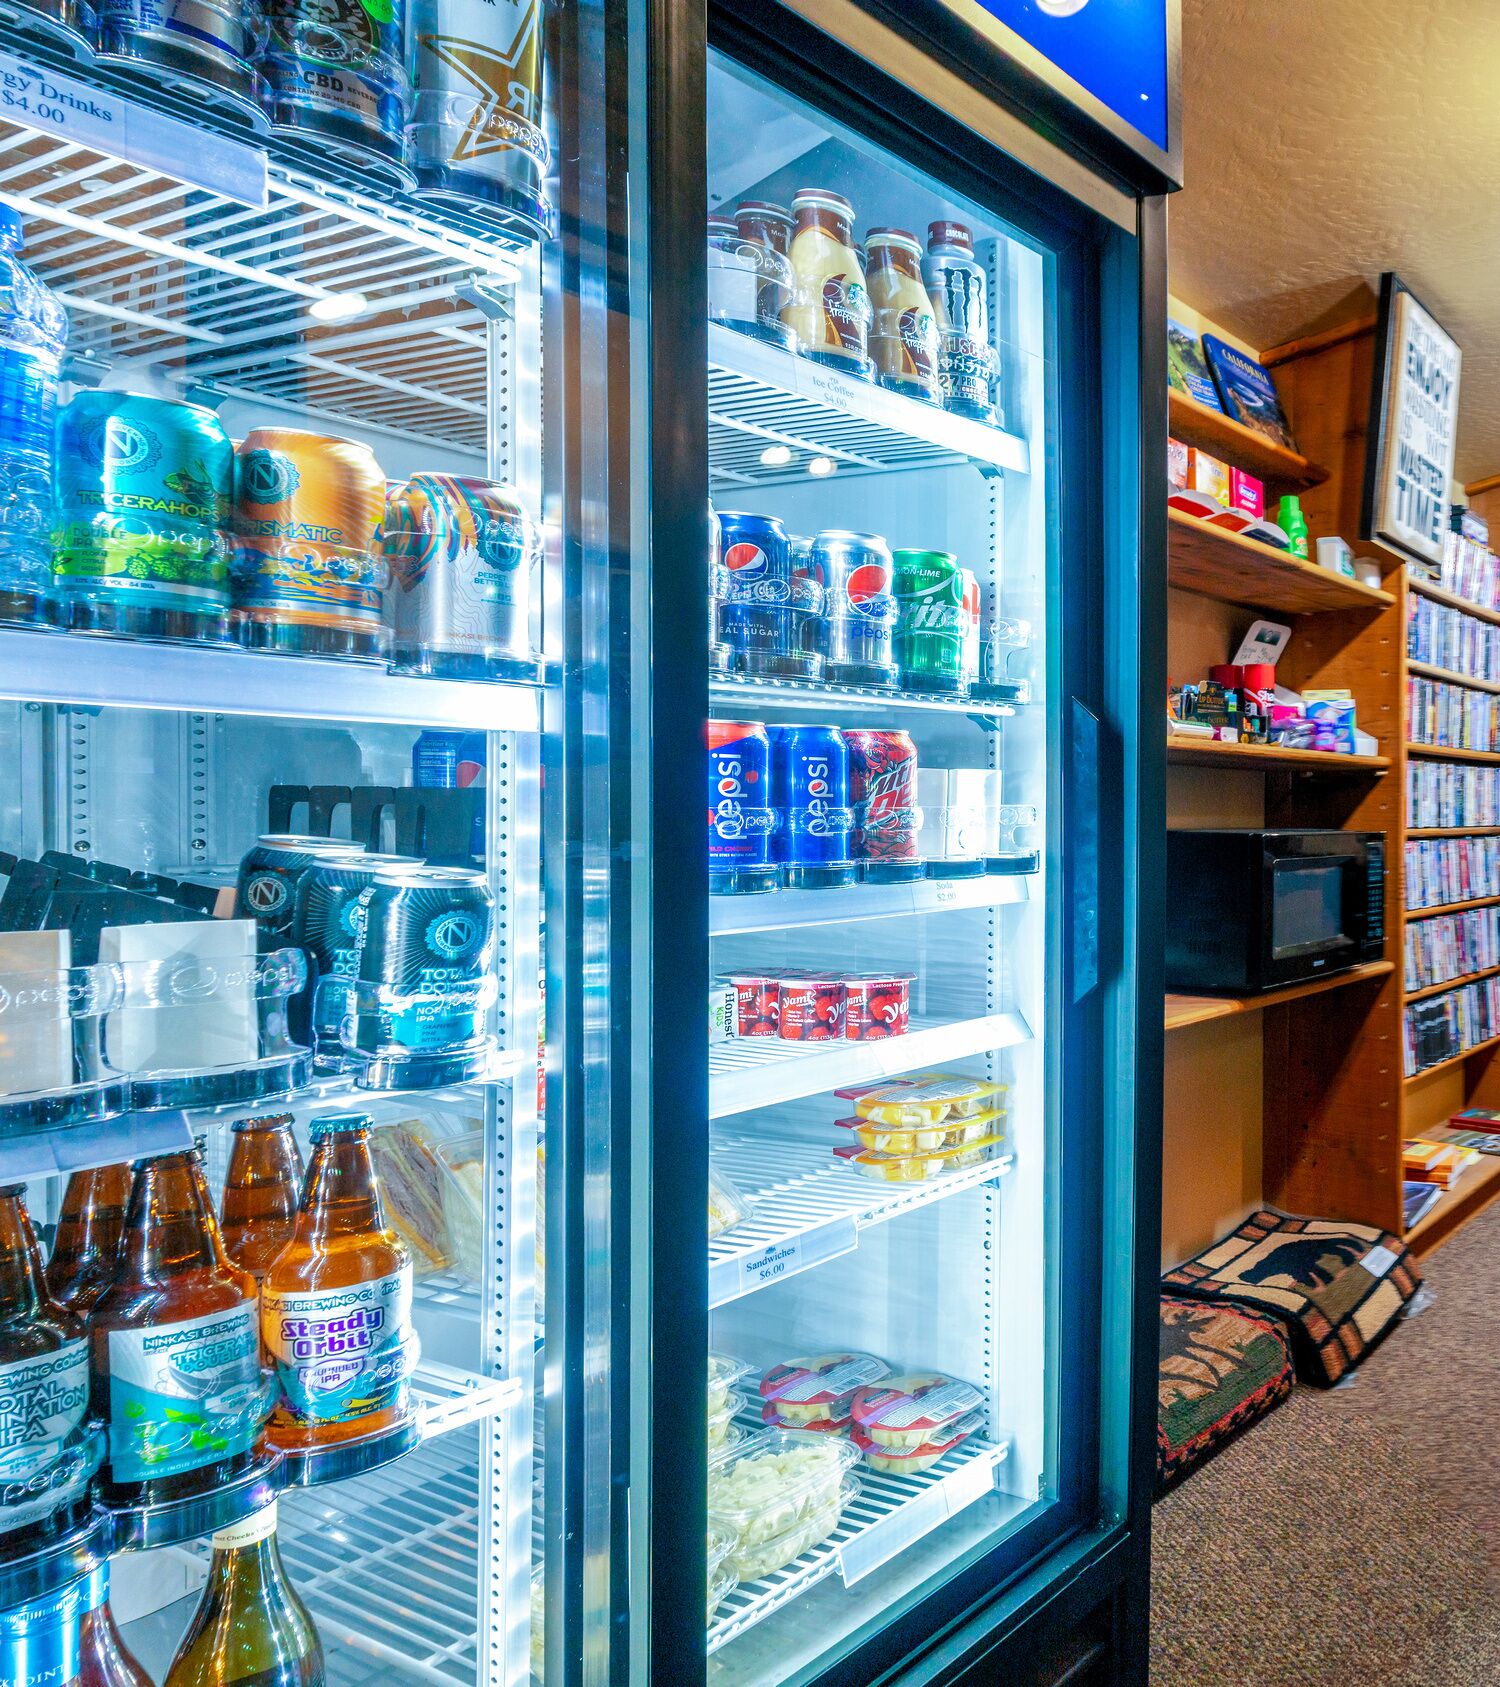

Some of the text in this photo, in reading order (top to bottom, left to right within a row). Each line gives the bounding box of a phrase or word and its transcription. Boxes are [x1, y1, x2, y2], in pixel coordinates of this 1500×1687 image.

[303, 69, 344, 92] CBD
[2, 88, 65, 124] $4.00
[39, 81, 113, 122] Drinks
[1221, 348, 1270, 386] CALIFORNIA
[1405, 338, 1452, 412] ENJOY
[812, 375, 856, 399] Ice Coffee
[1396, 437, 1446, 502] WASTED
[76, 488, 221, 523] TRICERAHOPS
[1392, 470, 1442, 546] TIME
[73, 527, 129, 541] DOUBLE
[73, 537, 94, 549] IPA
[743, 627, 780, 638] SUGAR
[711, 753, 748, 840] pepsi
[801, 756, 834, 837] pepsi
[936, 880, 954, 890] Soda
[936, 891, 957, 902] $2.00
[419, 966, 475, 982] TOTAL
[782, 990, 813, 1009] yami
[415, 1014, 435, 1023] IPA
[716, 1006, 724, 1028] KIDS
[724, 992, 735, 1039] Honest
[882, 1002, 909, 1025] ya
[746, 1247, 796, 1273] Sandwiches
[759, 1262, 785, 1281] $6.00
[293, 1291, 358, 1313] BREWING
[144, 1313, 250, 1351] NINKASI BREWING
[282, 1309, 383, 1340] Steady
[294, 1331, 370, 1358] Orbit
[320, 1374, 341, 1384] IPA
[133, 1467, 165, 1478] DOUBLE
